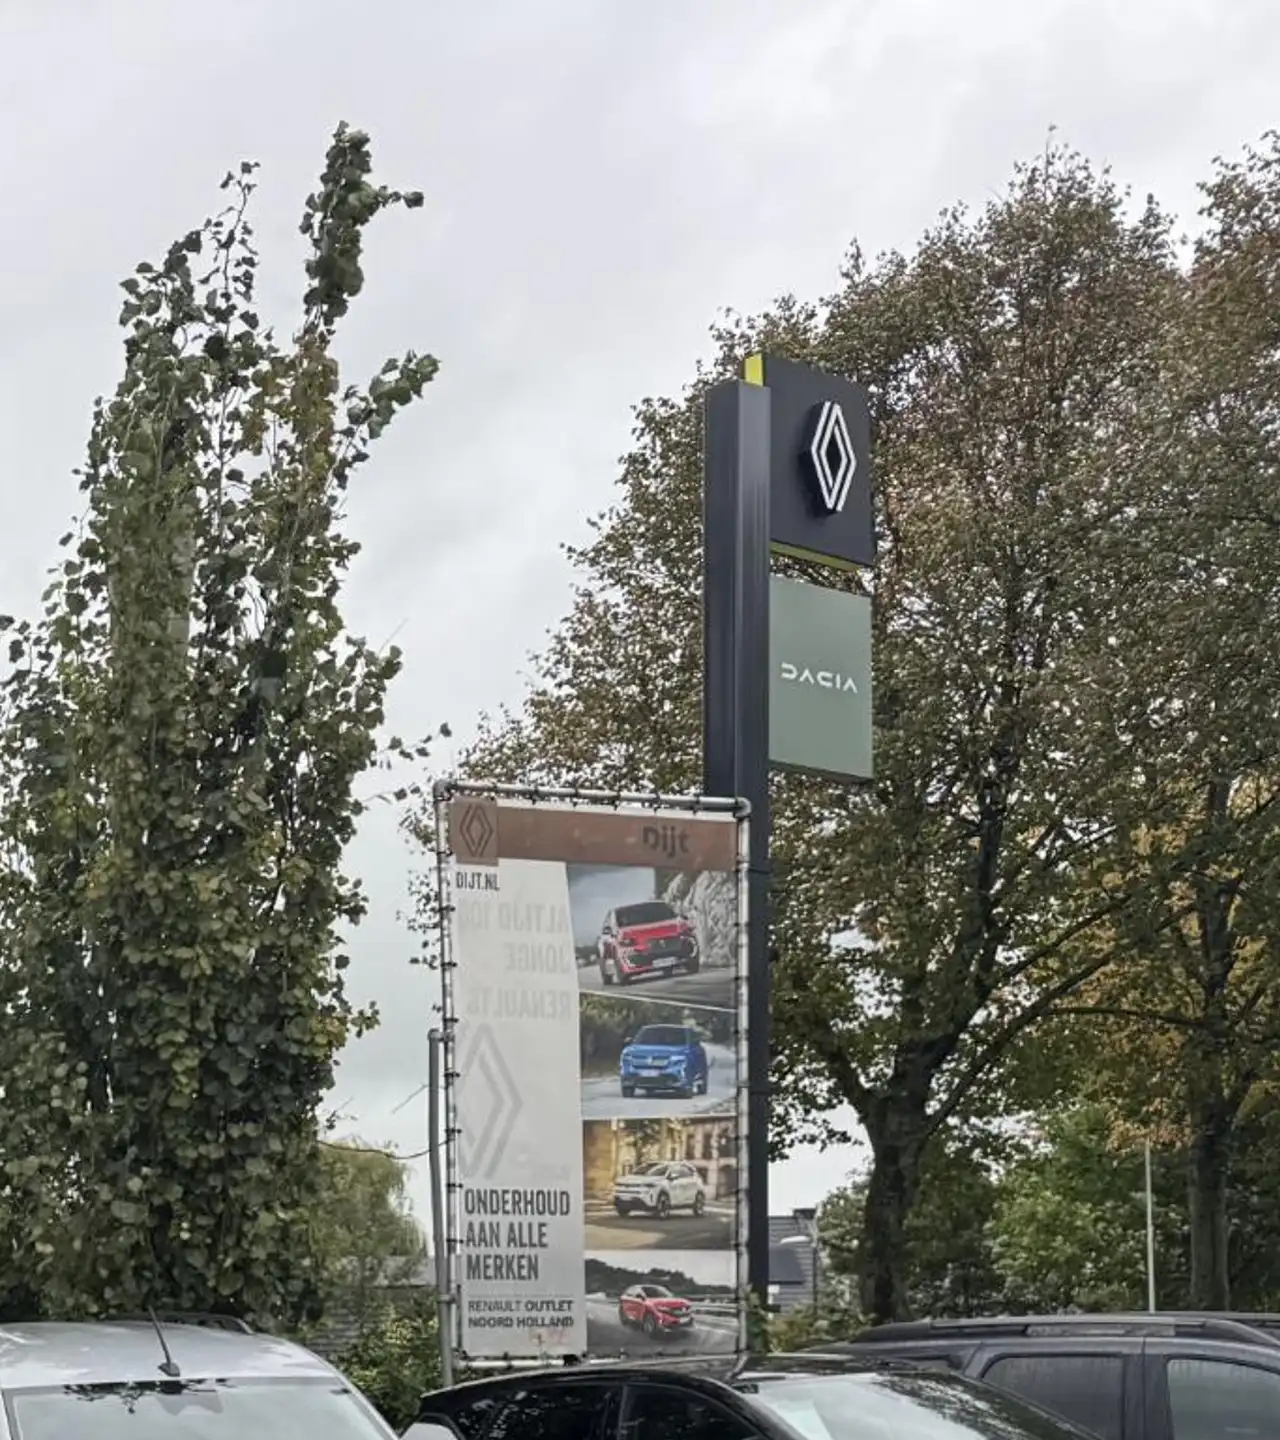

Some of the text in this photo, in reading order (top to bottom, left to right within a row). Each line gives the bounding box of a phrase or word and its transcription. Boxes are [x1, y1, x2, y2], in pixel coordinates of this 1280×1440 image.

[781, 661, 859, 695] DACIA
[643, 825, 691, 857] Dijt
[456, 871, 501, 892] DIJT.NL
[464, 1188, 571, 1216] ONDERHOUD
[465, 1221, 549, 1249] AAN ALLE
[466, 1254, 540, 1281] MERKEN
[467, 1299, 574, 1312] RENAULT OUTLET
[467, 1315, 574, 1329] NOORD HOLLAND
